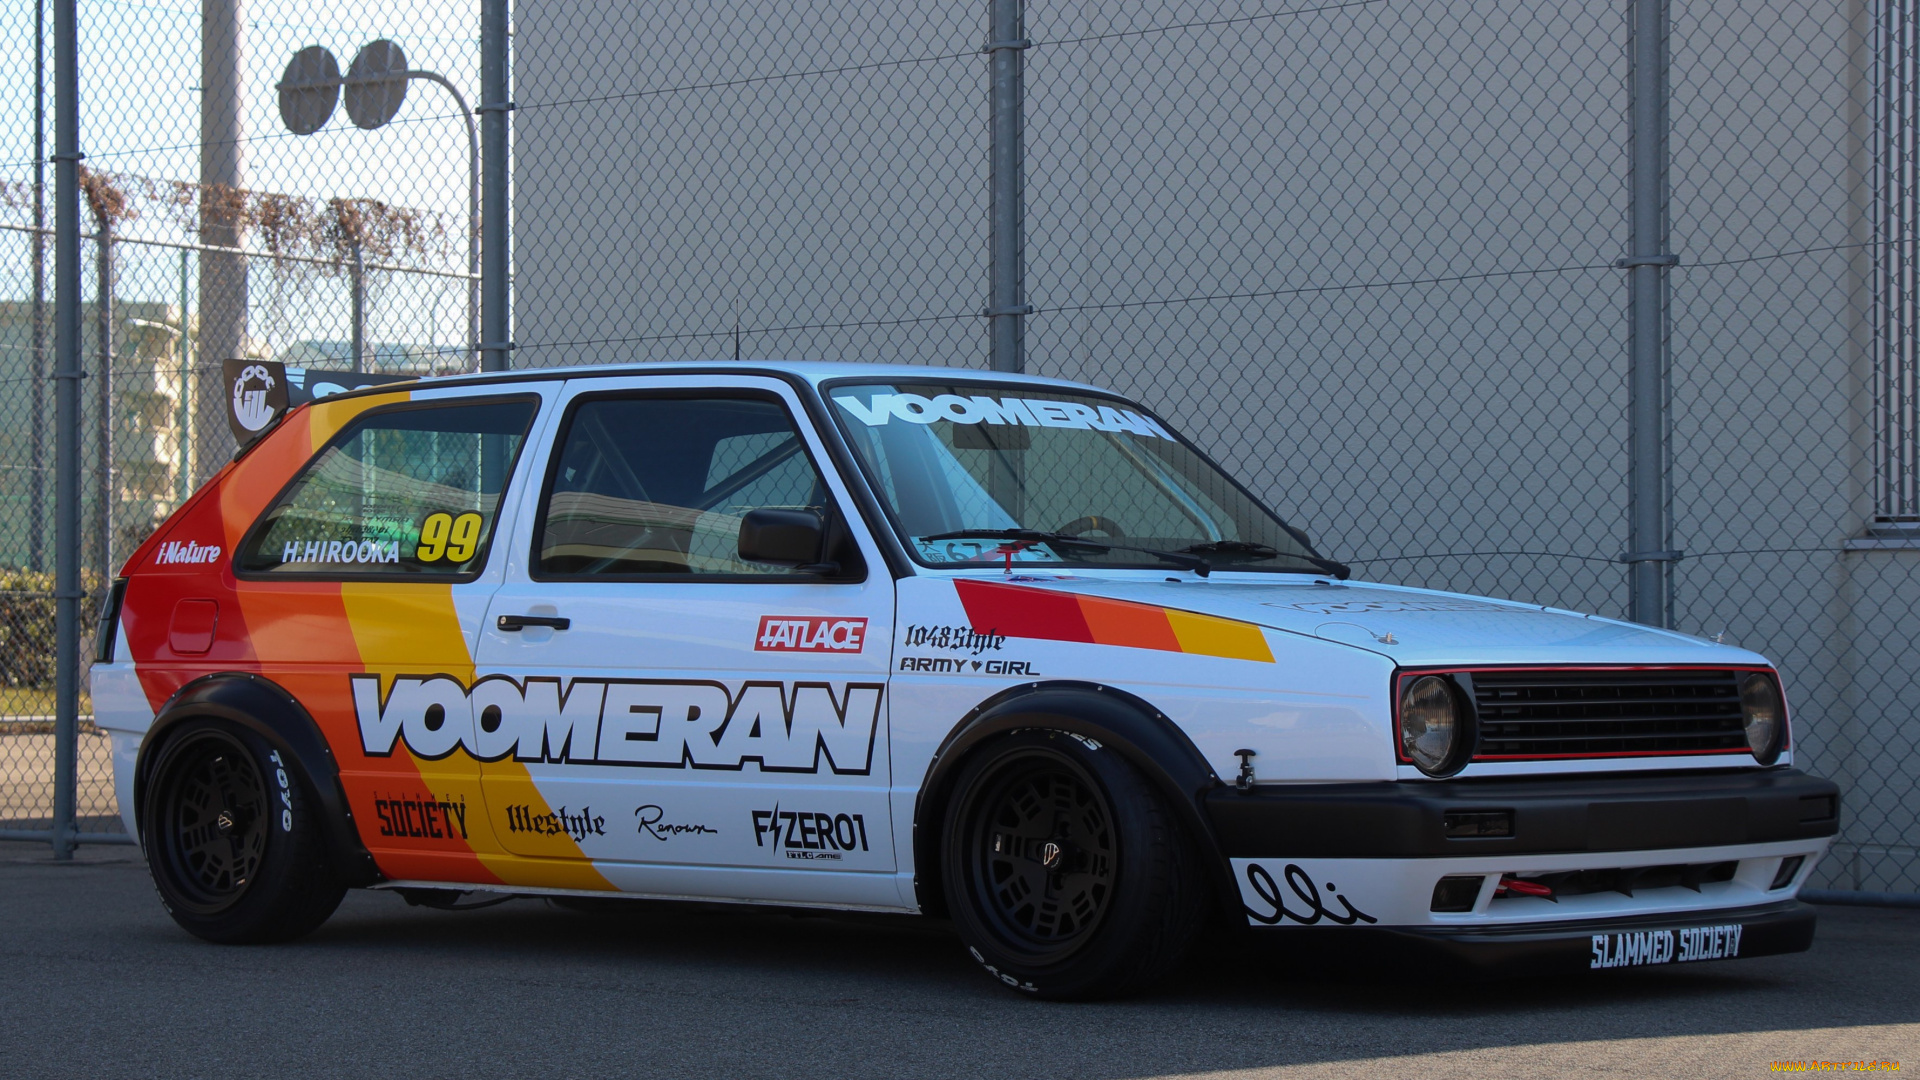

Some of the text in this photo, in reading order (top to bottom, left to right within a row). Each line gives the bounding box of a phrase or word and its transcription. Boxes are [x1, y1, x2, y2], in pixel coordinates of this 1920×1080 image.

[832, 392, 1178, 442] VOOMERAN
[281, 540, 400, 564] H.HIROOKA
[416, 511, 484, 563] 99
[758, 619, 864, 650] FATLACE
[899, 657, 1041, 676] ARMY GIRL
[348, 672, 886, 776] VOOMERAN
[269, 748, 293, 832] TOYO
[374, 799, 468, 840] SOCIETY
[1590, 924, 1743, 969] SLAMMED SOCIETY
